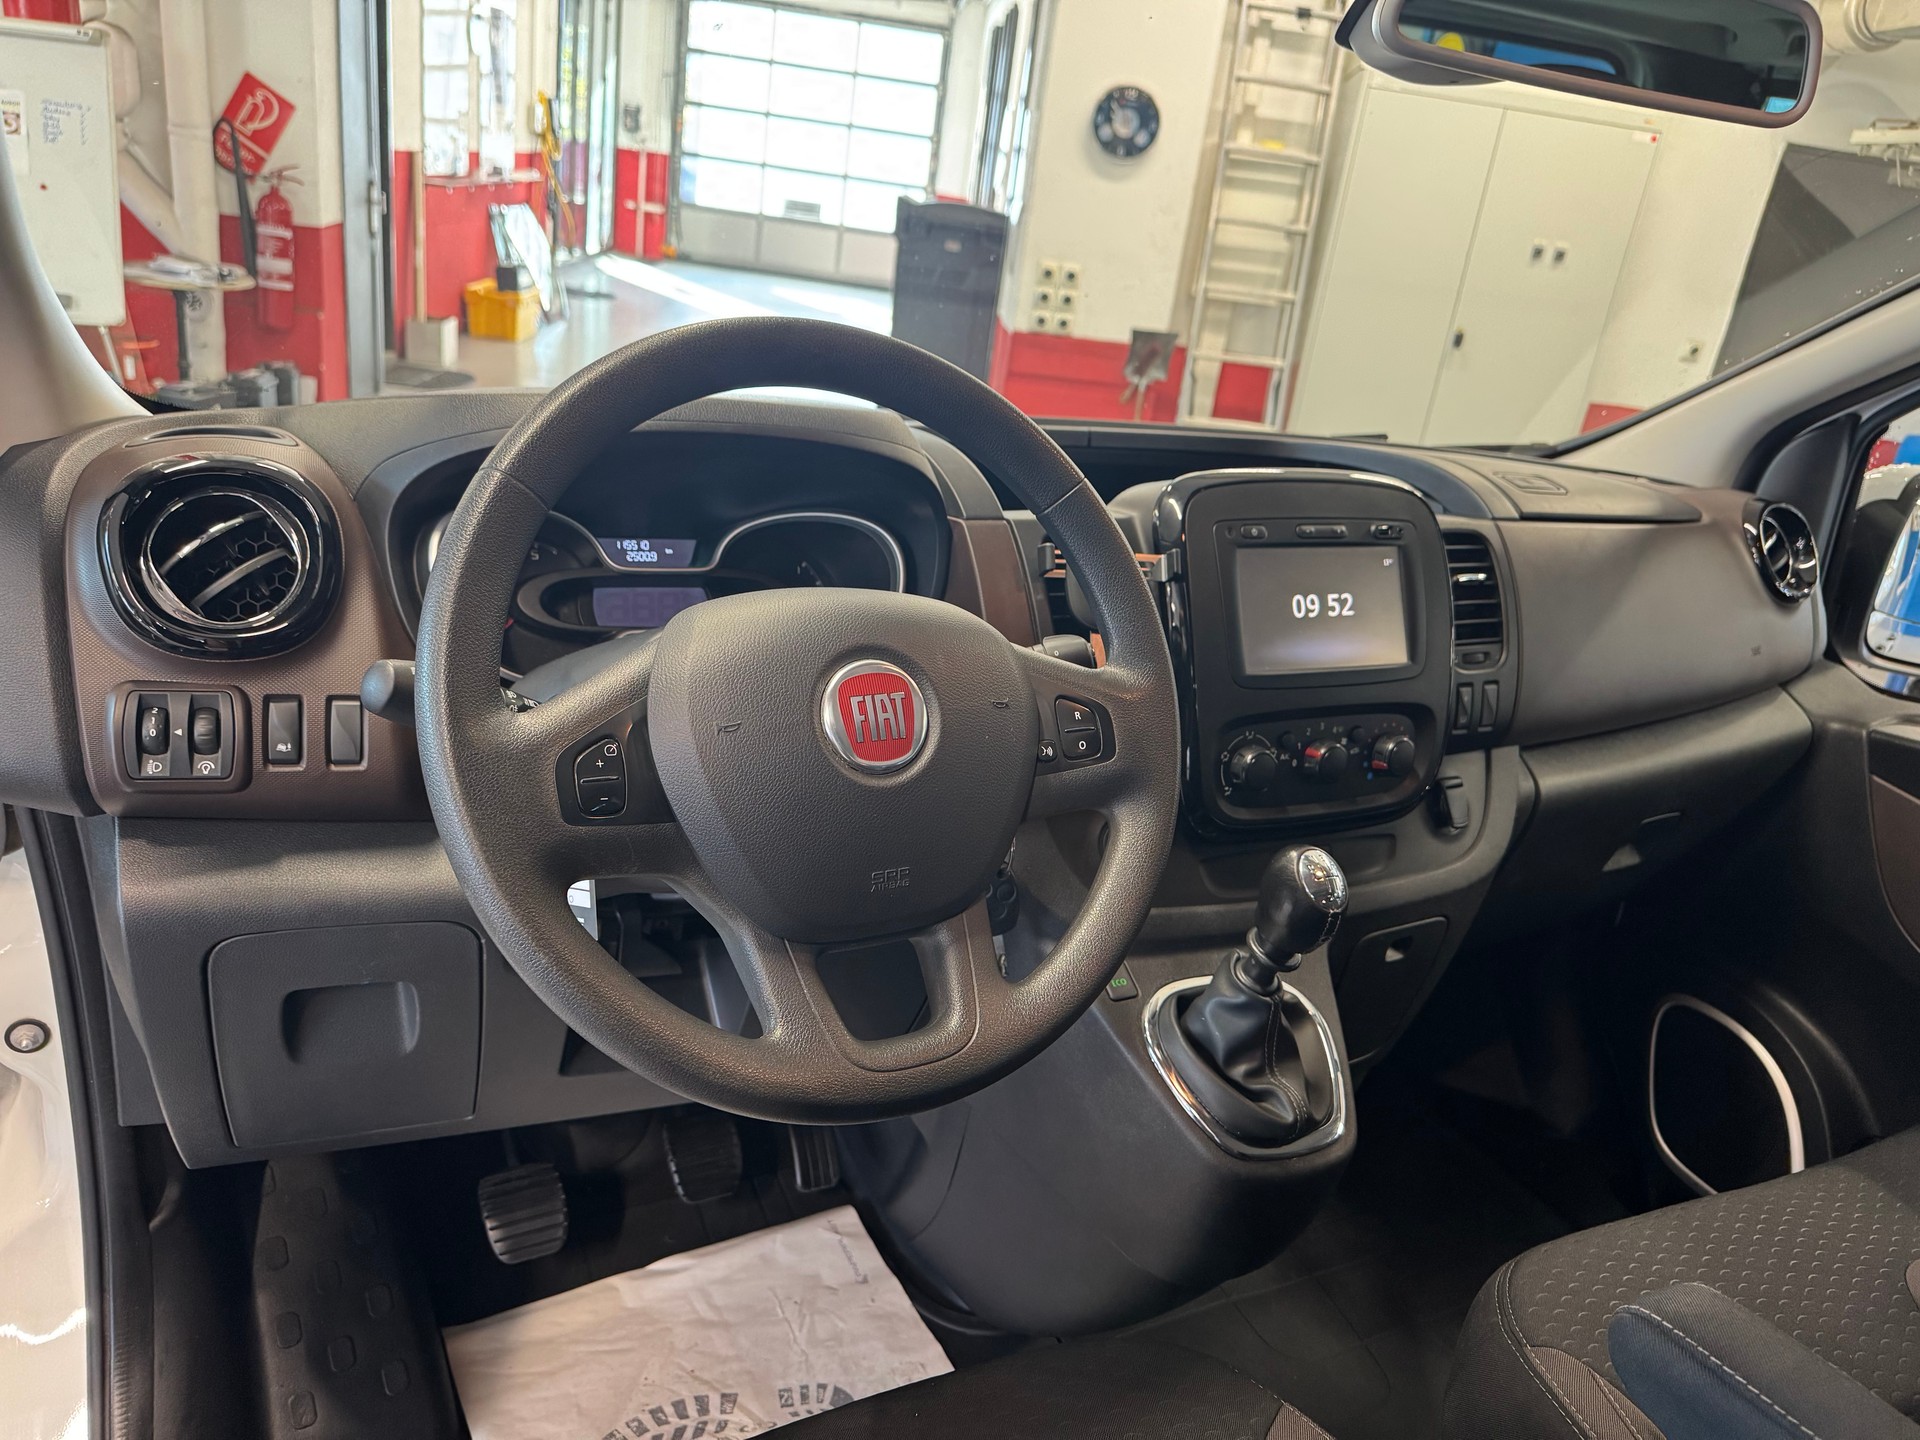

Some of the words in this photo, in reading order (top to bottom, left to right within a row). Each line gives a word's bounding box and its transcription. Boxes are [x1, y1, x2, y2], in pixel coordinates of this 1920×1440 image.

[1291, 594, 1321, 618] 09
[1326, 593, 1355, 617] 52
[151, 716, 156, 725] 1
[850, 691, 907, 743] FIAT
[1074, 711, 1082, 721] R
[870, 878, 910, 893] AIRBAG
